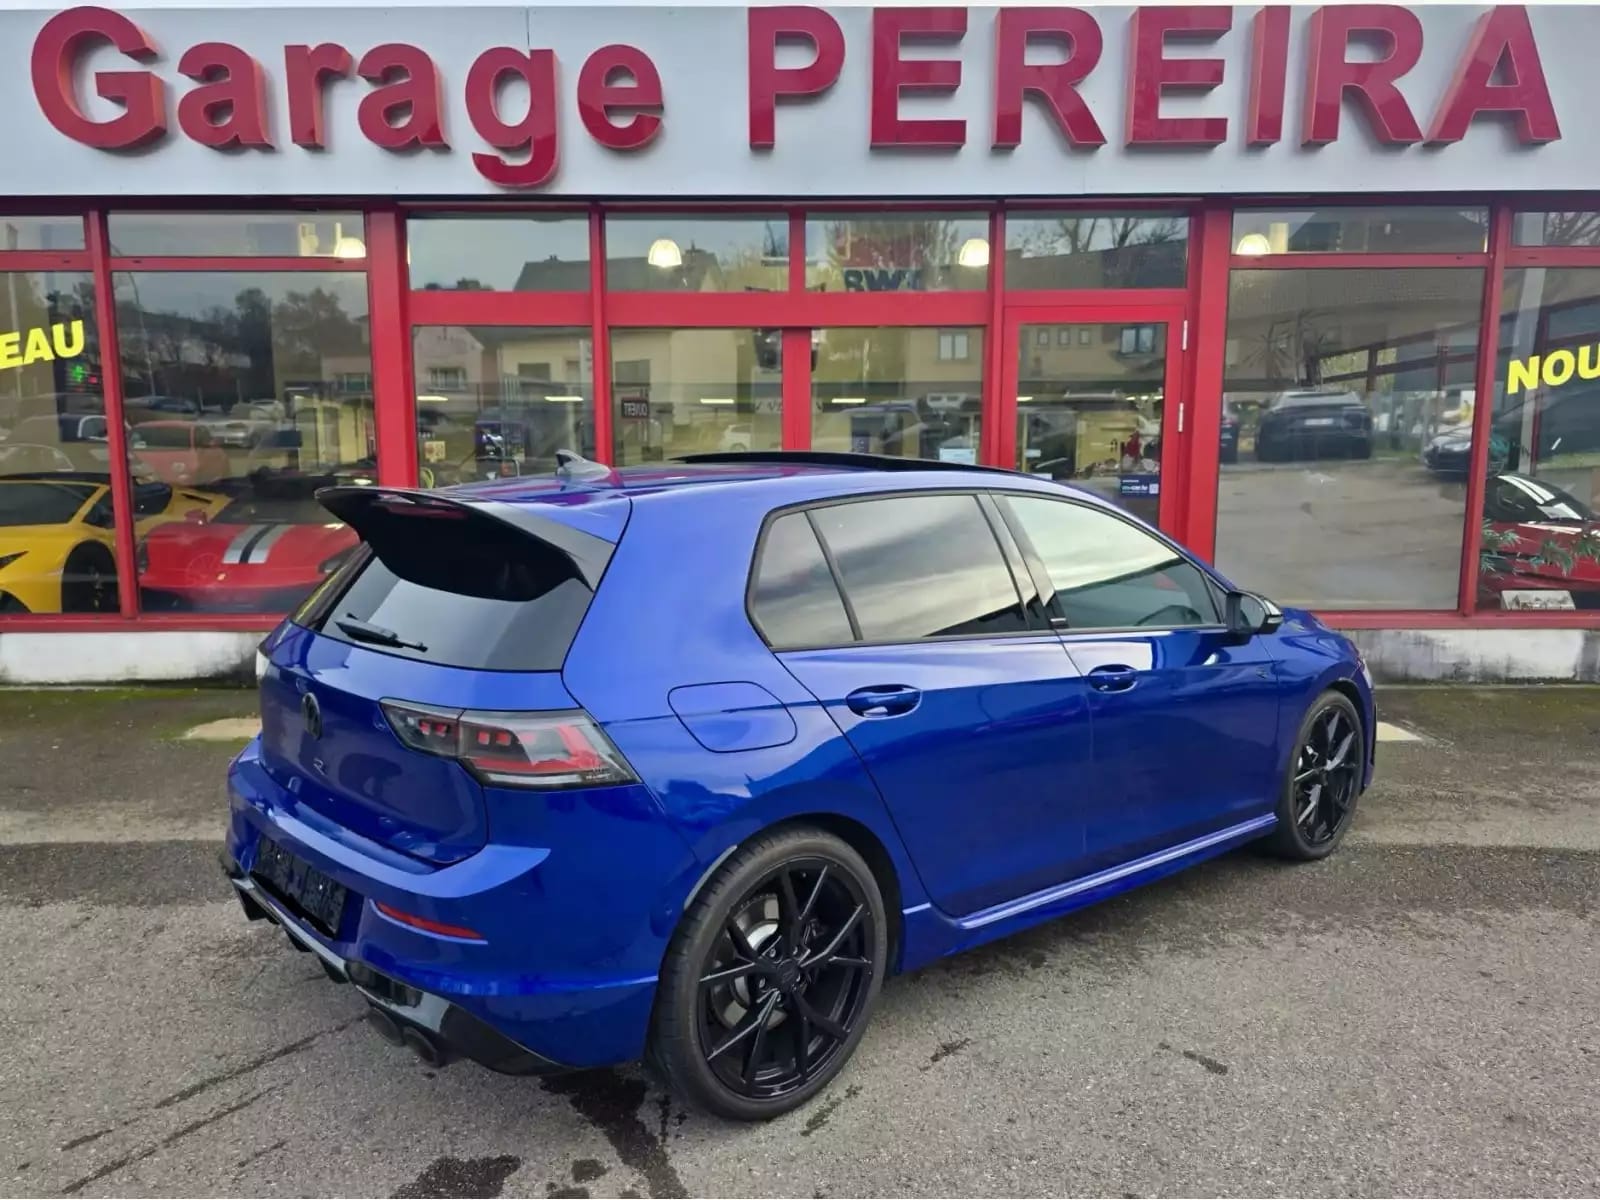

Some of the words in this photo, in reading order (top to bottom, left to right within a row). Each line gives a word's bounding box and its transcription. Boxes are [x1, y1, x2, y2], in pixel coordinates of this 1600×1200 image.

[31, 6, 664, 189] Garage
[747, 5, 1562, 153] PEREIRA
[0, 320, 84, 369] EAU
[1507, 342, 1600, 395] NOU
